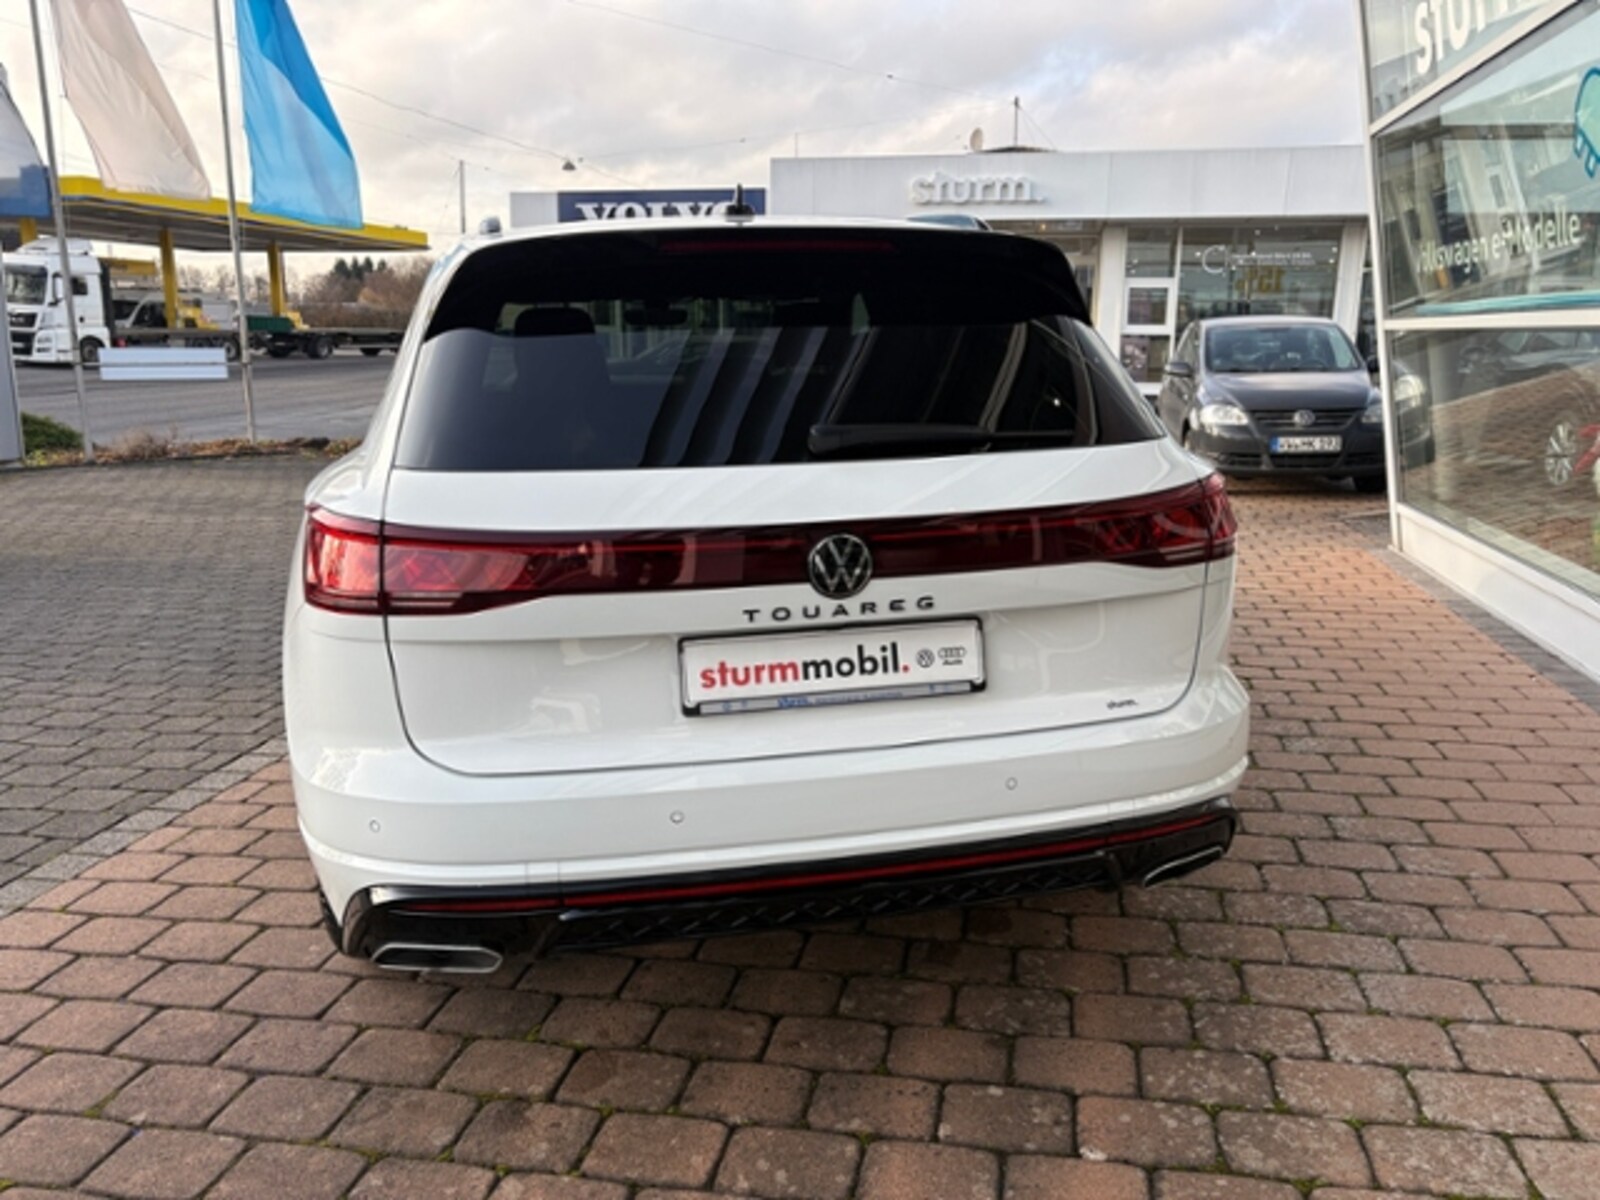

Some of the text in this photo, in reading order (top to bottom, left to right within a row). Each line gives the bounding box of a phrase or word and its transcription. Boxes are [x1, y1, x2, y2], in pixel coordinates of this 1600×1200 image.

[1414, 0, 1508, 75] stu
[911, 171, 1047, 204] sturm.
[742, 596, 935, 623] TOUAREG
[699, 641, 910, 690] sturmmobil.
